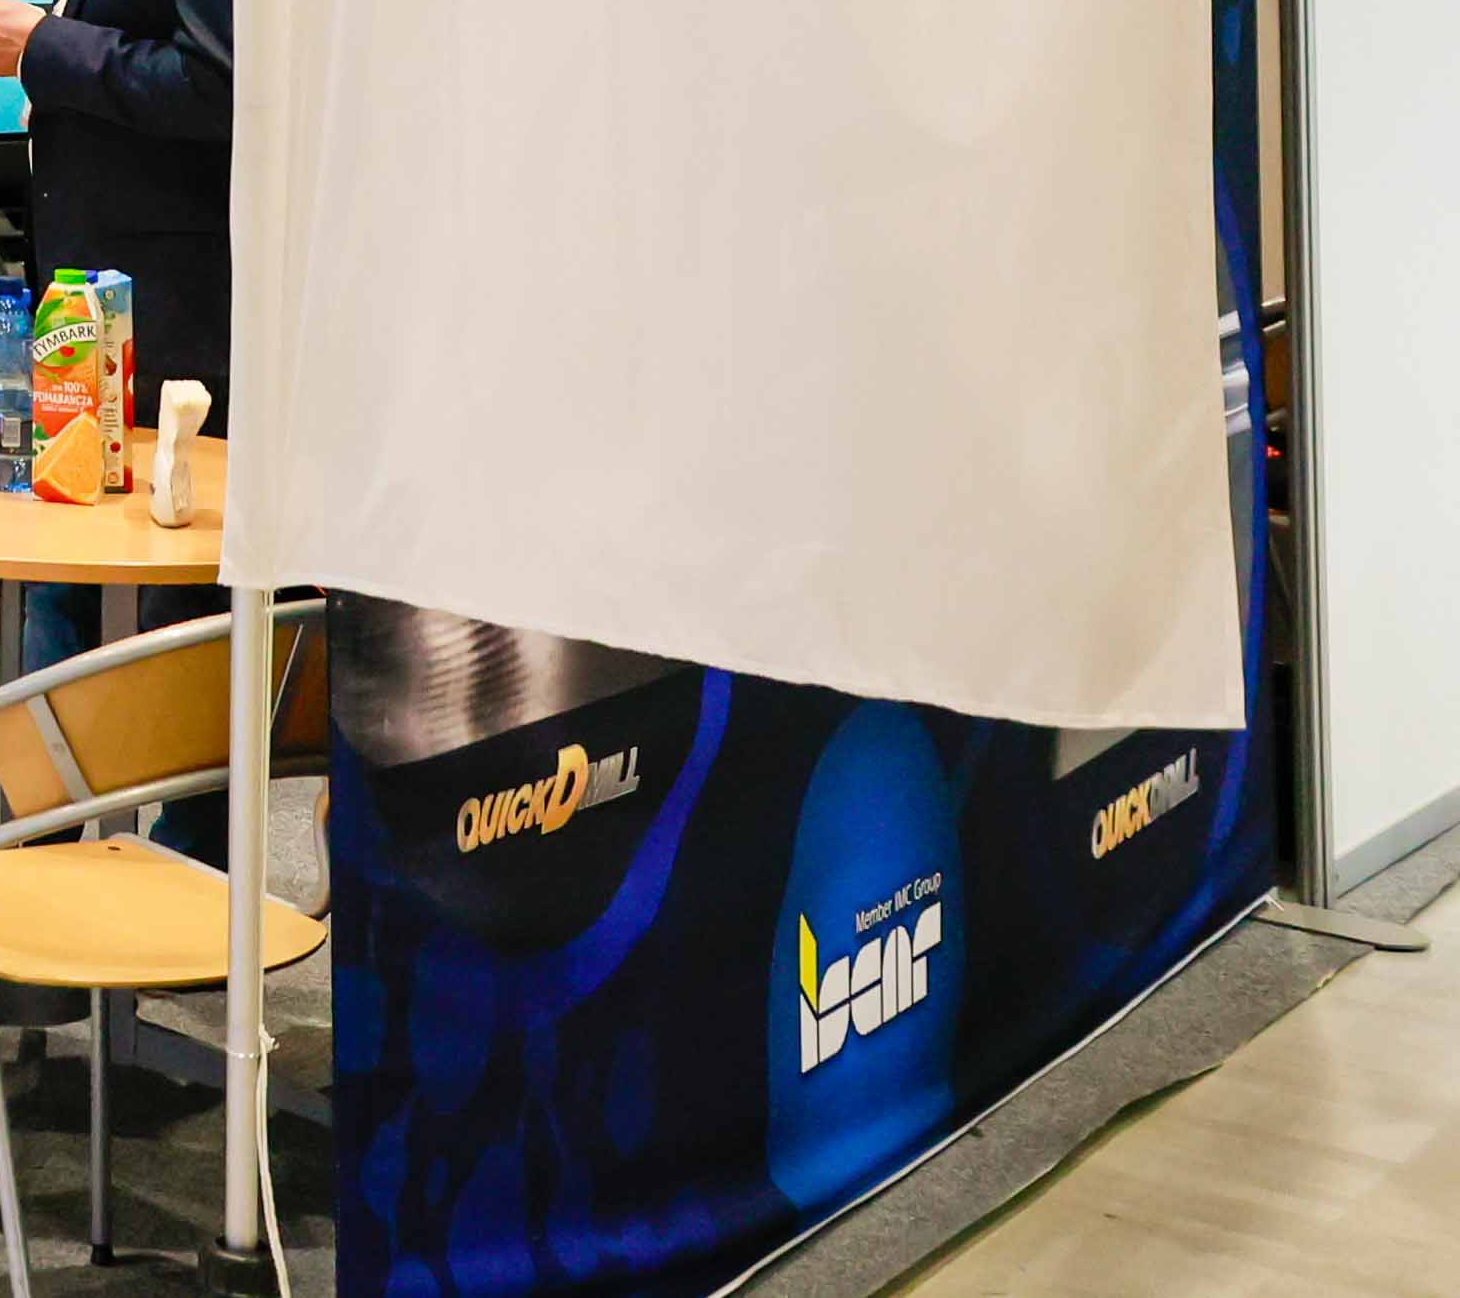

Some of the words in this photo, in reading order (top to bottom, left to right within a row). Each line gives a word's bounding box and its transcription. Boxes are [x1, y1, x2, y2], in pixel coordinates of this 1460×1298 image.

[34, 324, 96, 357] TYMBARK
[855, 898, 893, 934] Member
[894, 883, 913, 912] IMC
[913, 871, 942, 900] Group
